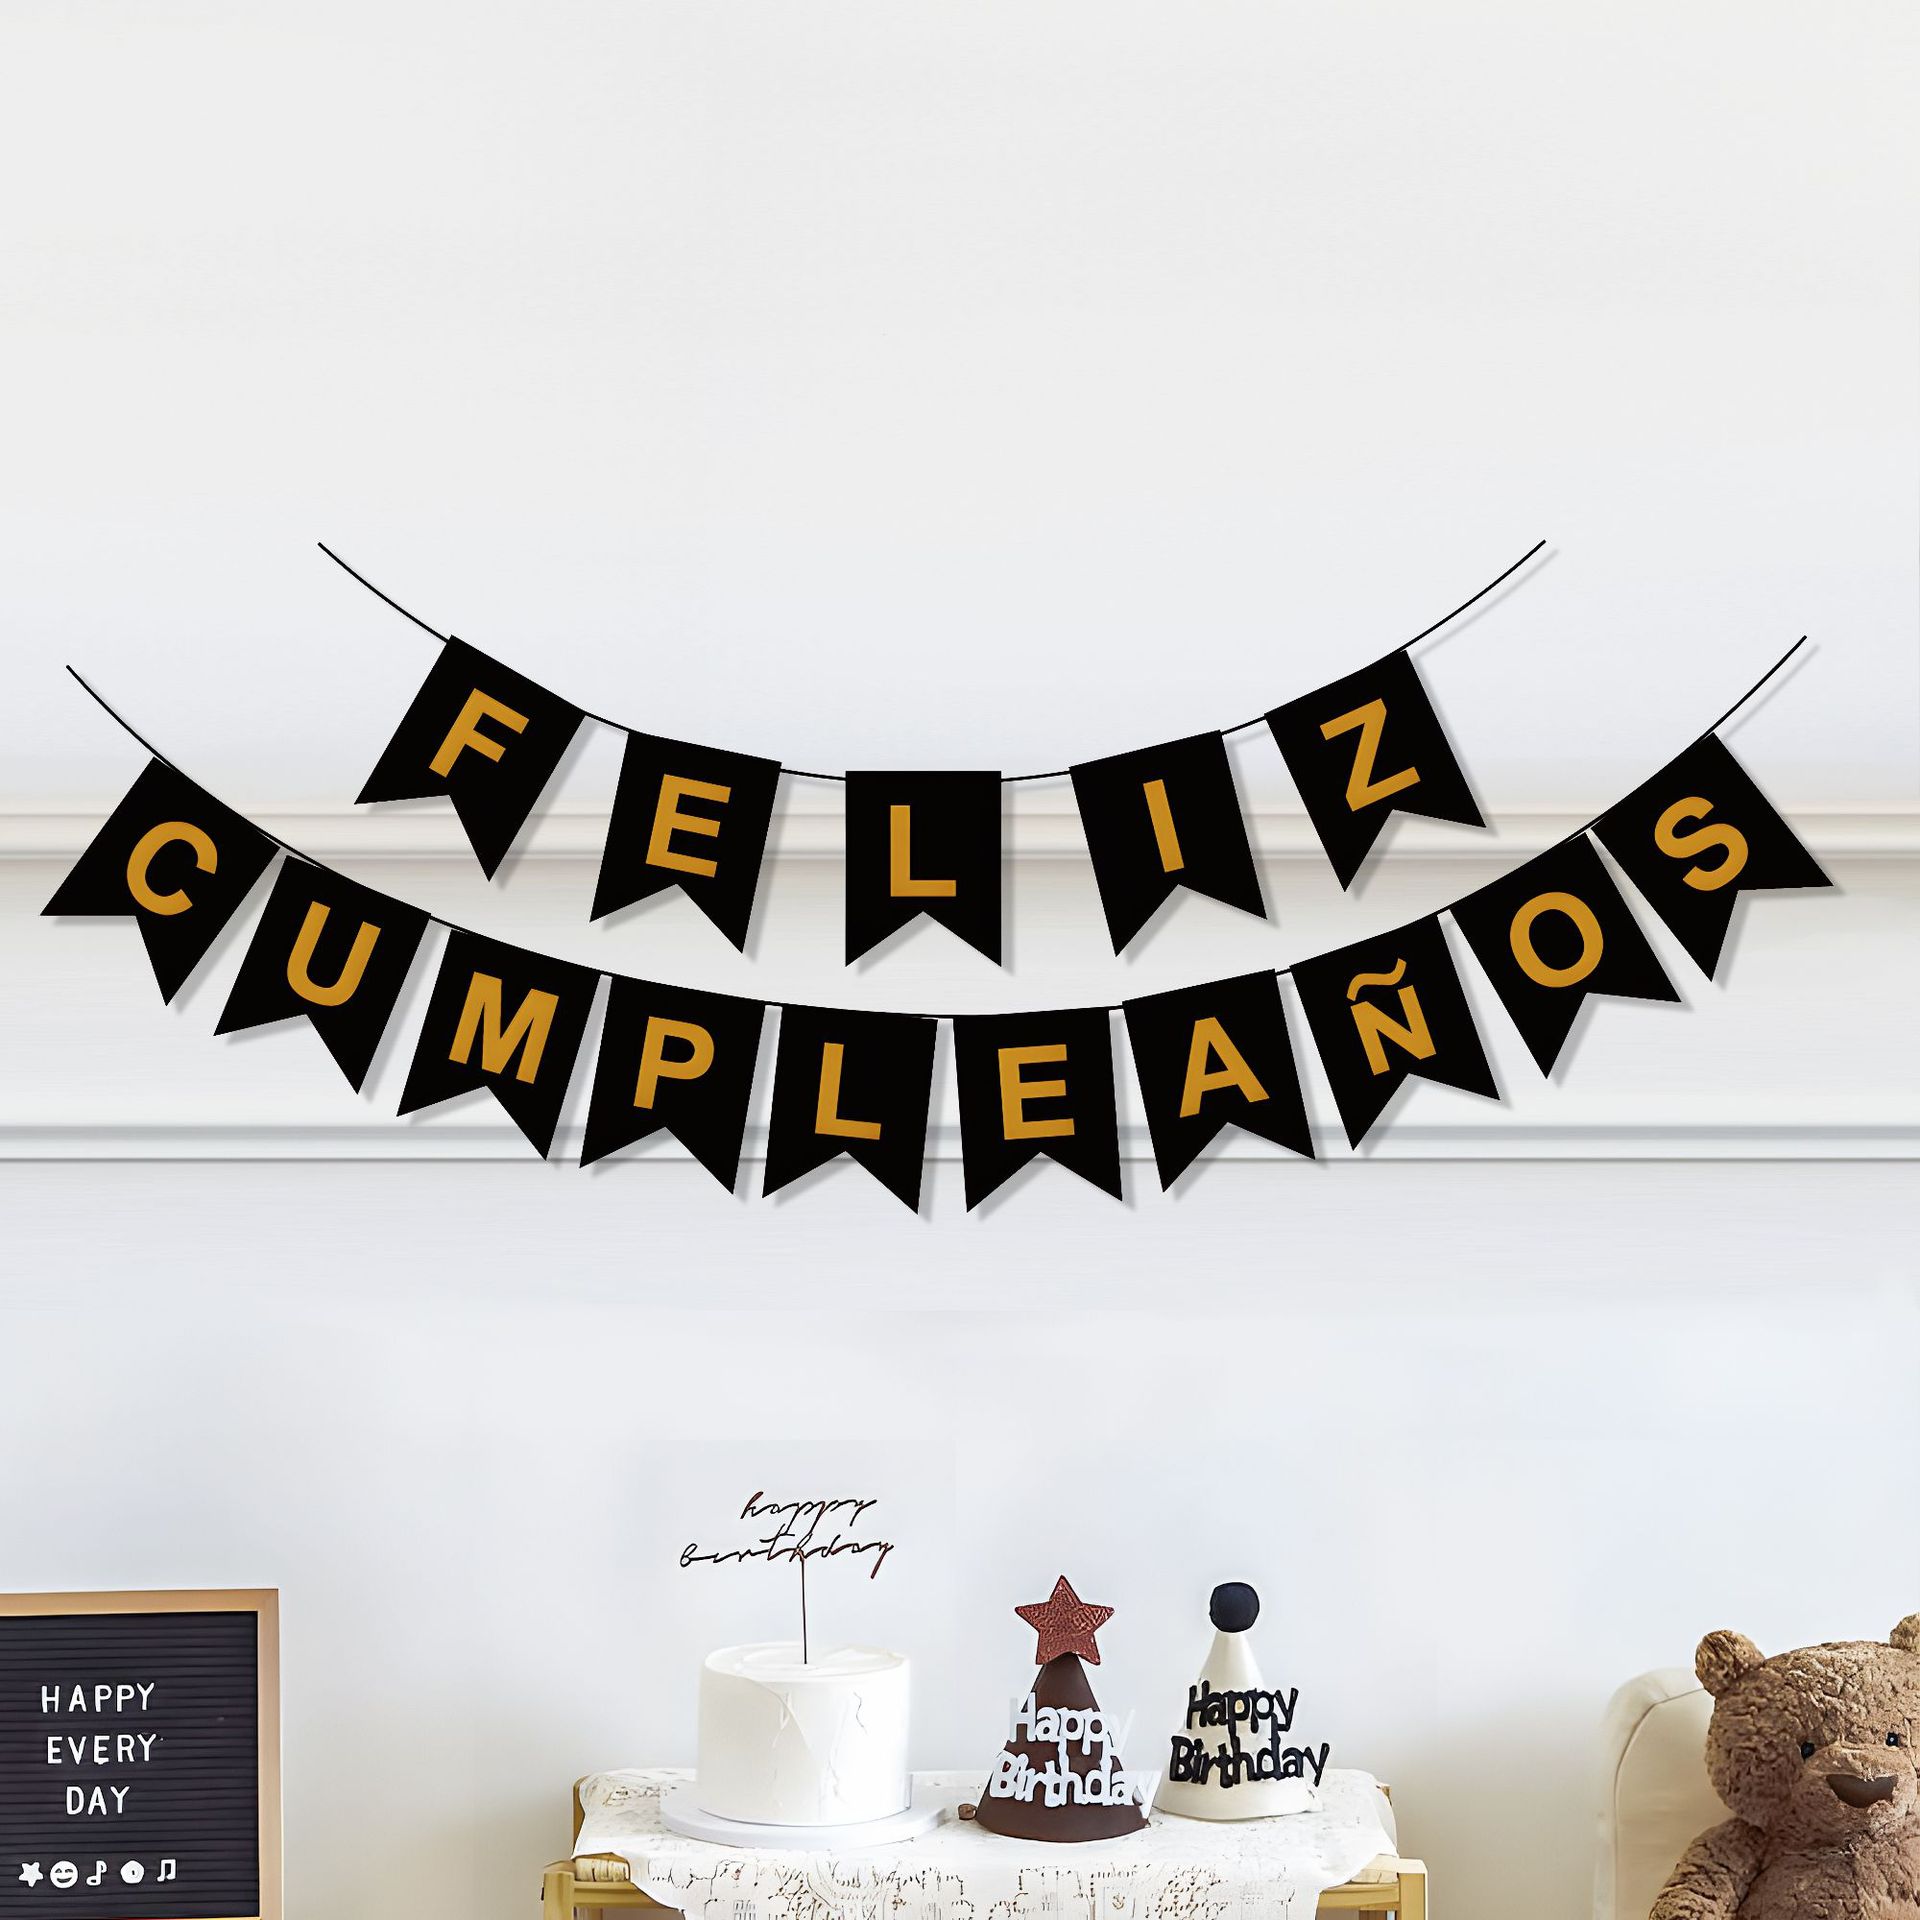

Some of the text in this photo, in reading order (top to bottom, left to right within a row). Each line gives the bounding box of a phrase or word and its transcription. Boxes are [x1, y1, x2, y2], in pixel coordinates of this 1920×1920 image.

[430, 688, 1420, 897] FELIZ
[127, 797, 1749, 1140] CUMPLEAÑOS
[740, 1491, 877, 1534] happy
[41, 1682, 155, 1713] HAPPY
[1186, 1680, 1299, 1735] Happy
[47, 1733, 156, 1765] EVERY
[1169, 1735, 1330, 1788] Birthday
[66, 1785, 130, 1816] DAY
